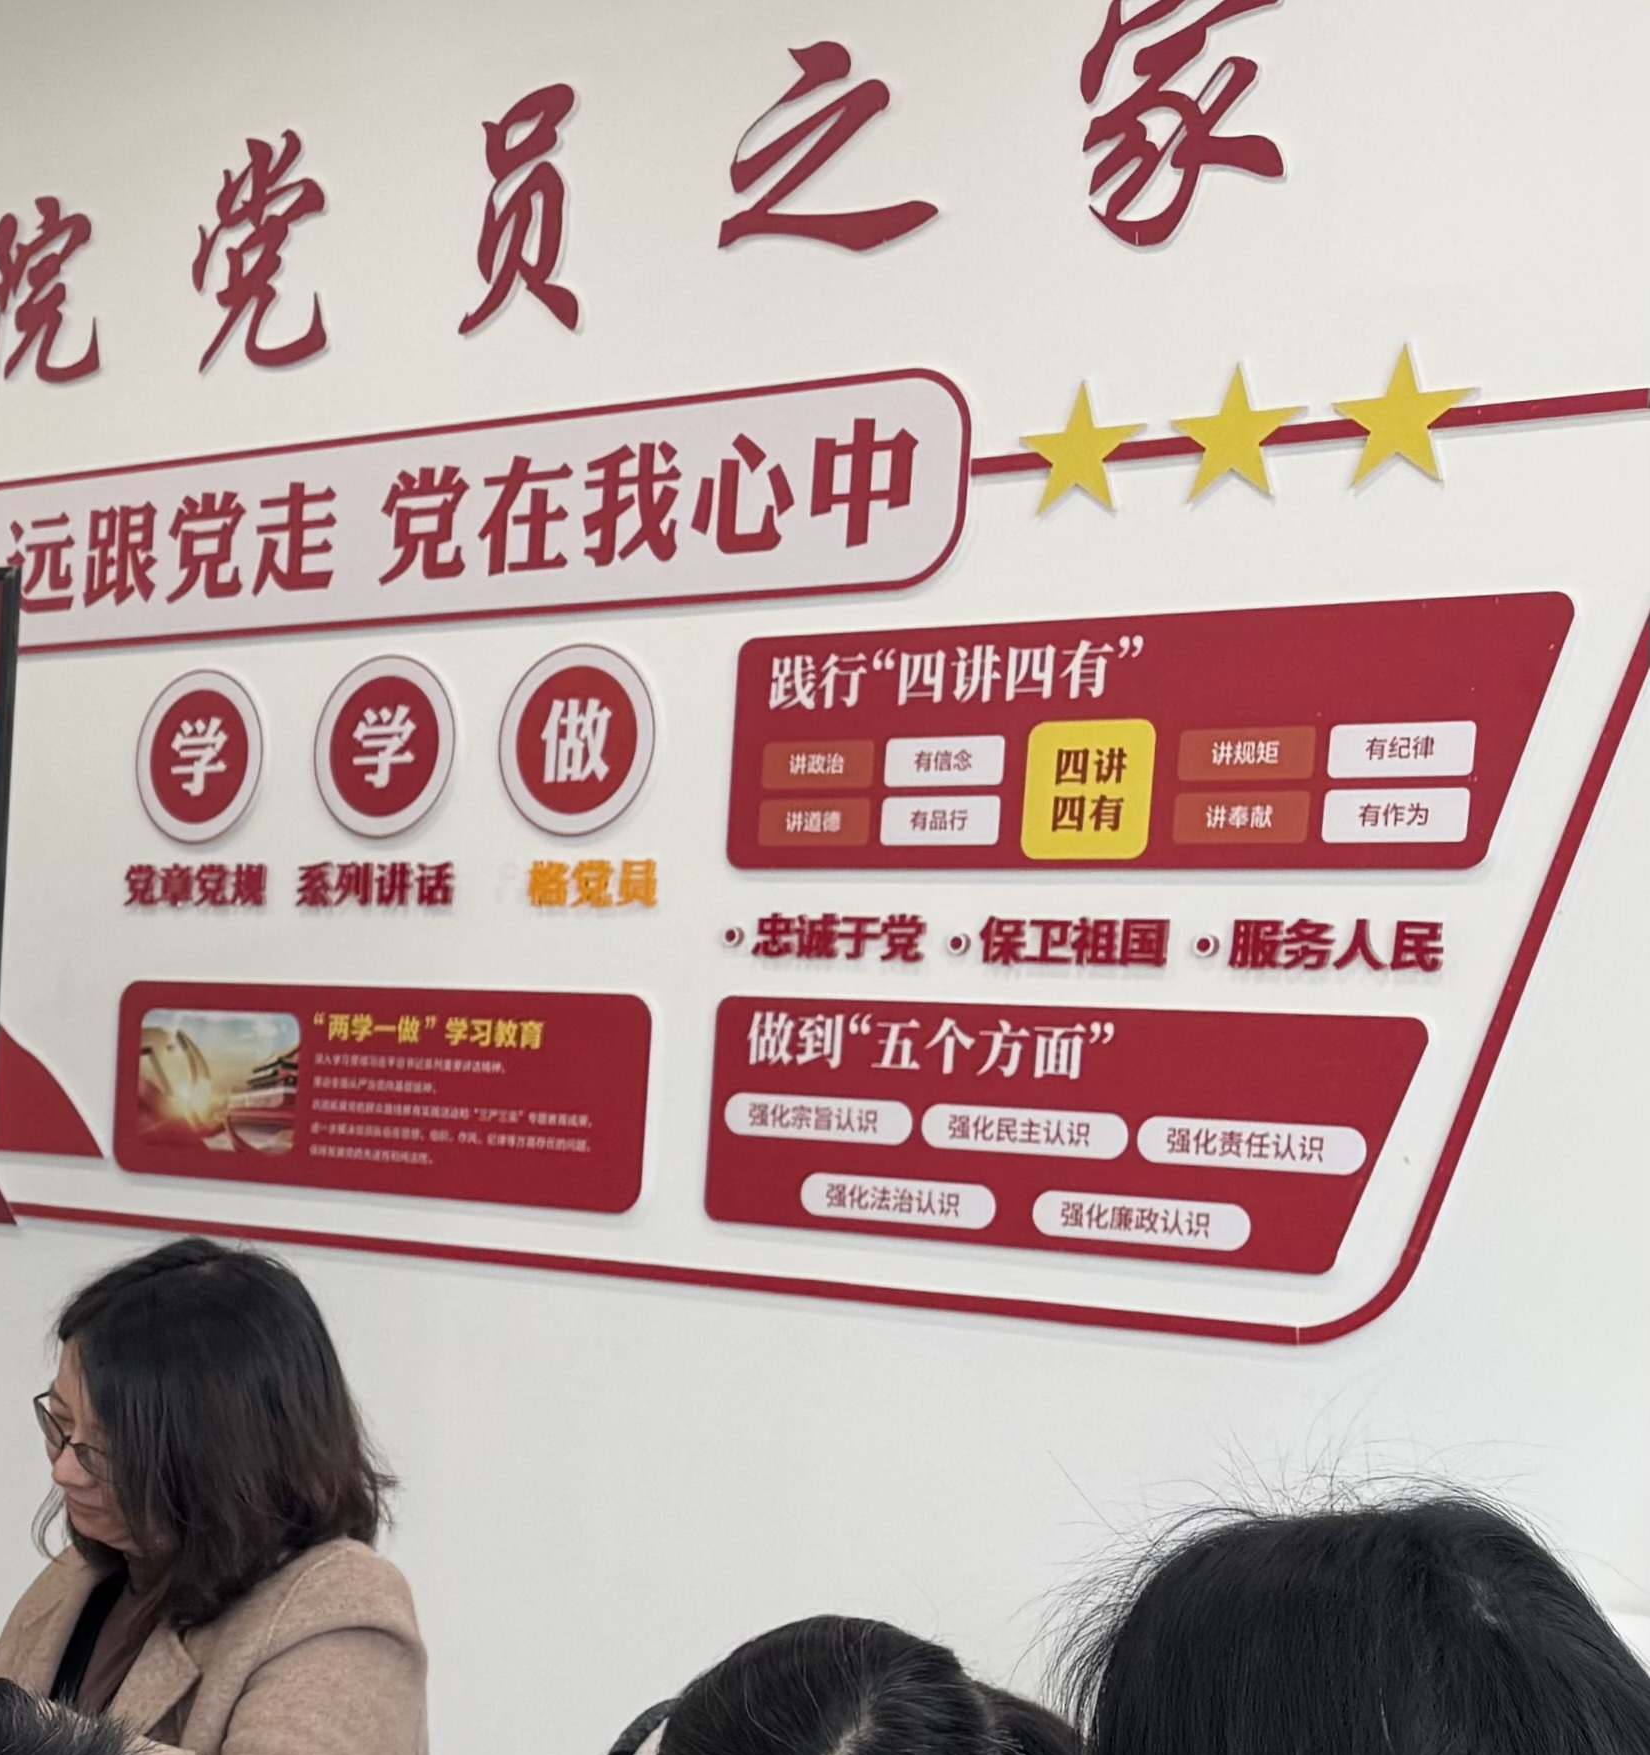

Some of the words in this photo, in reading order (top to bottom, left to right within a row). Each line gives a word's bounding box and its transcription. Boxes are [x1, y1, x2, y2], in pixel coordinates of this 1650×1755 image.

[380, 415, 917, 587] 党在我心中
[768, 635, 1145, 710] 践行“四讲四有”
[170, 717, 228, 796] 学
[352, 705, 417, 788] 学
[540, 699, 611, 783] 做
[1210, 740, 1280, 766] 讲规矩
[1365, 734, 1435, 762] 有纪律
[789, 752, 845, 775] 讲政治
[913, 748, 973, 774] 有信念
[1055, 746, 1127, 786] 四讲
[785, 810, 841, 833] 讲道德
[909, 807, 969, 832] 有品行
[1051, 794, 1124, 833] 四有
[1205, 804, 1274, 830] 讲奉献
[1357, 801, 1430, 829] 有作为
[124, 863, 267, 907] 党章党规
[297, 861, 454, 907] 系列讲话
[753, 913, 927, 963] 忠诚于党
[979, 917, 1170, 968] 保卫祖国
[1228, 918, 1444, 973] 服务人民
[747, 1011, 1116, 1081] 做到“五个方面”
[748, 1102, 879, 1135] 强化宗旨认识
[948, 1114, 1092, 1147] 强化民主认识
[1166, 1127, 1324, 1164] 强化责任认识
[825, 1184, 960, 1218] 强化法治认识
[1059, 1202, 1211, 1238] 强化廉政认识
